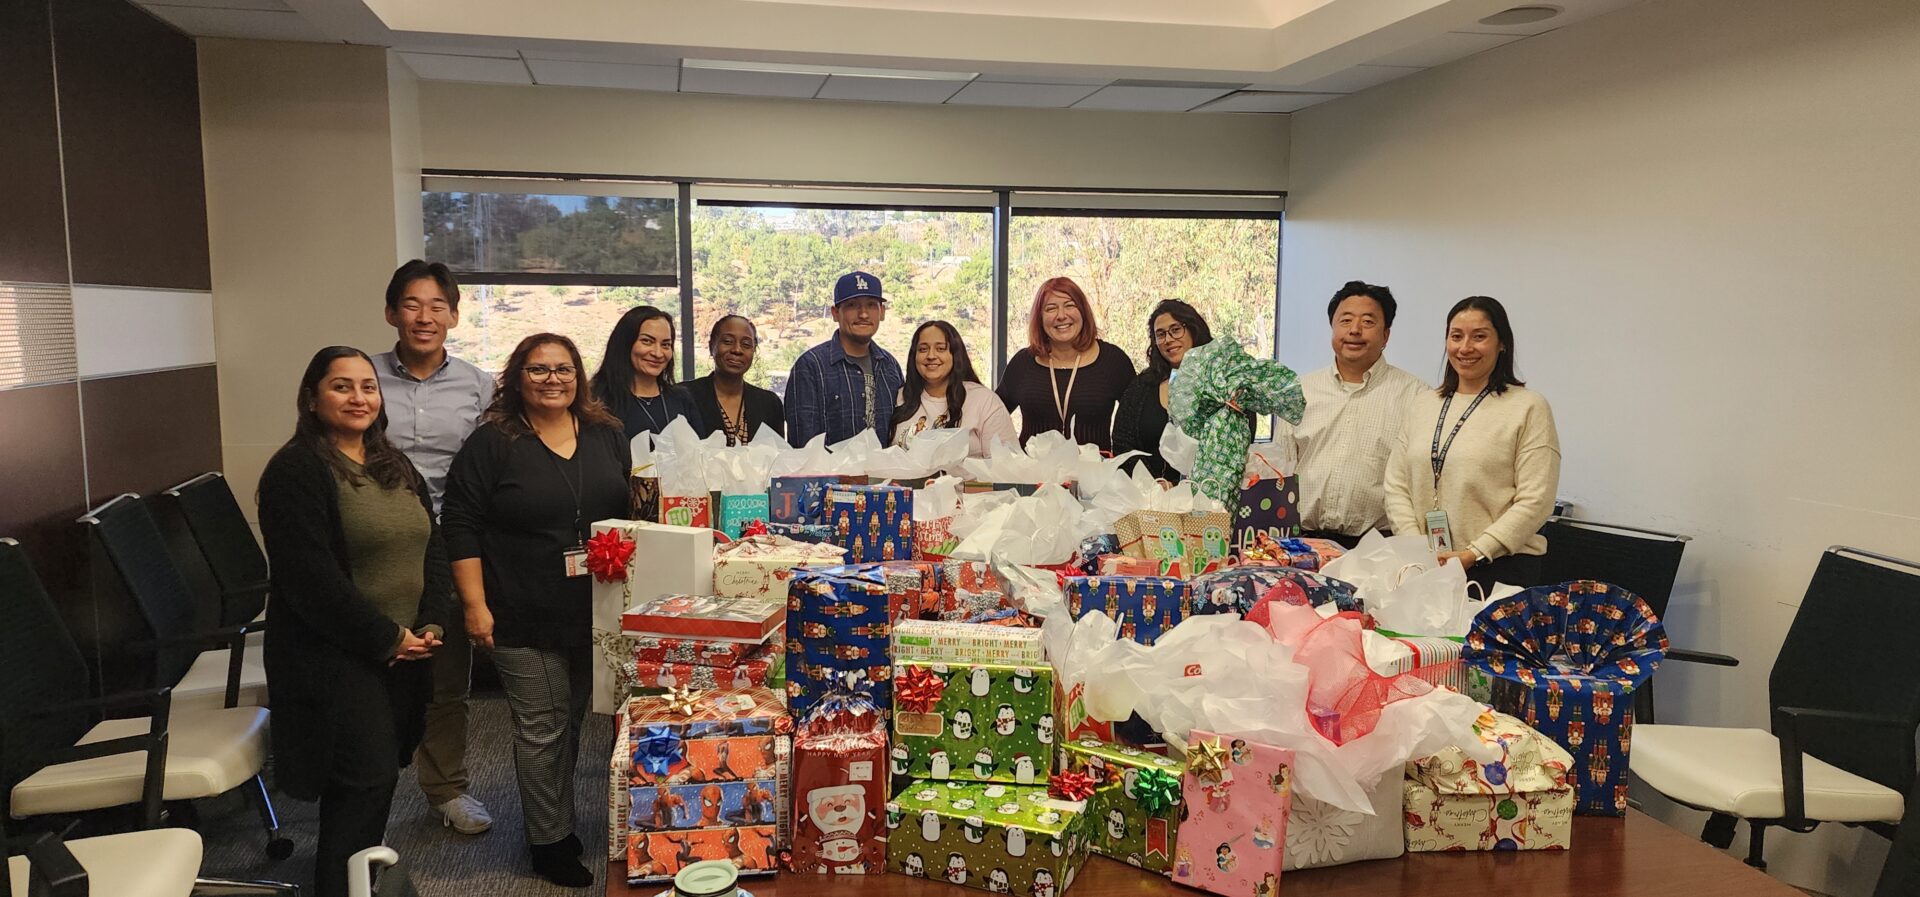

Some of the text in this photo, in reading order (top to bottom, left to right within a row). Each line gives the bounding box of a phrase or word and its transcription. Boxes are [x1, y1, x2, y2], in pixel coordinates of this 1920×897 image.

[855, 275, 869, 290] LA
[938, 637, 960, 646] MERRY
[972, 639, 999, 647] BRIGHT
[1003, 640, 1028, 649] MERRY
[921, 646, 944, 656] MERRY
[986, 649, 1009, 658] MERRY
